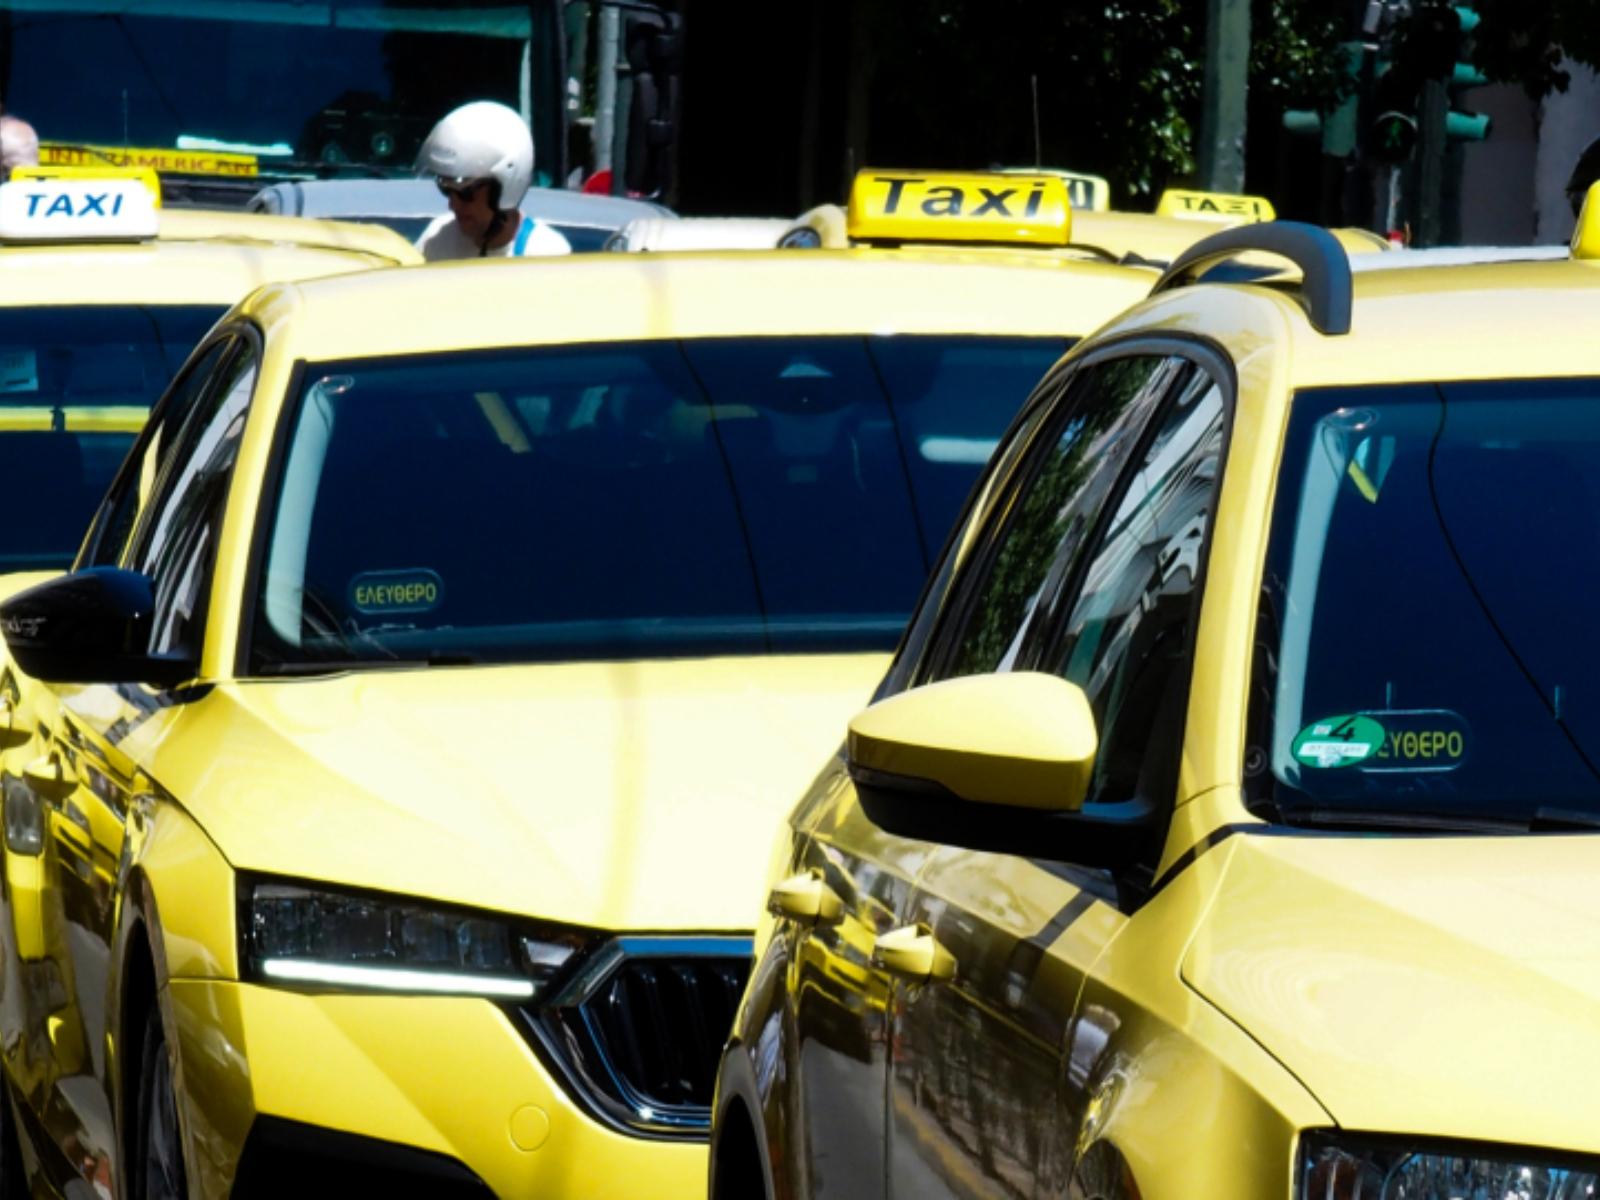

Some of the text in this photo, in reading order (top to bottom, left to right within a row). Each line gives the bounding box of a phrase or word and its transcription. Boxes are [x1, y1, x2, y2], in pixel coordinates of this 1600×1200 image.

[25, 193, 124, 217] TAXI
[874, 177, 1047, 219] Taxi
[355, 582, 437, 605] ΕΛΕΥΘΕΡΟ
[1328, 714, 1357, 741] 4
